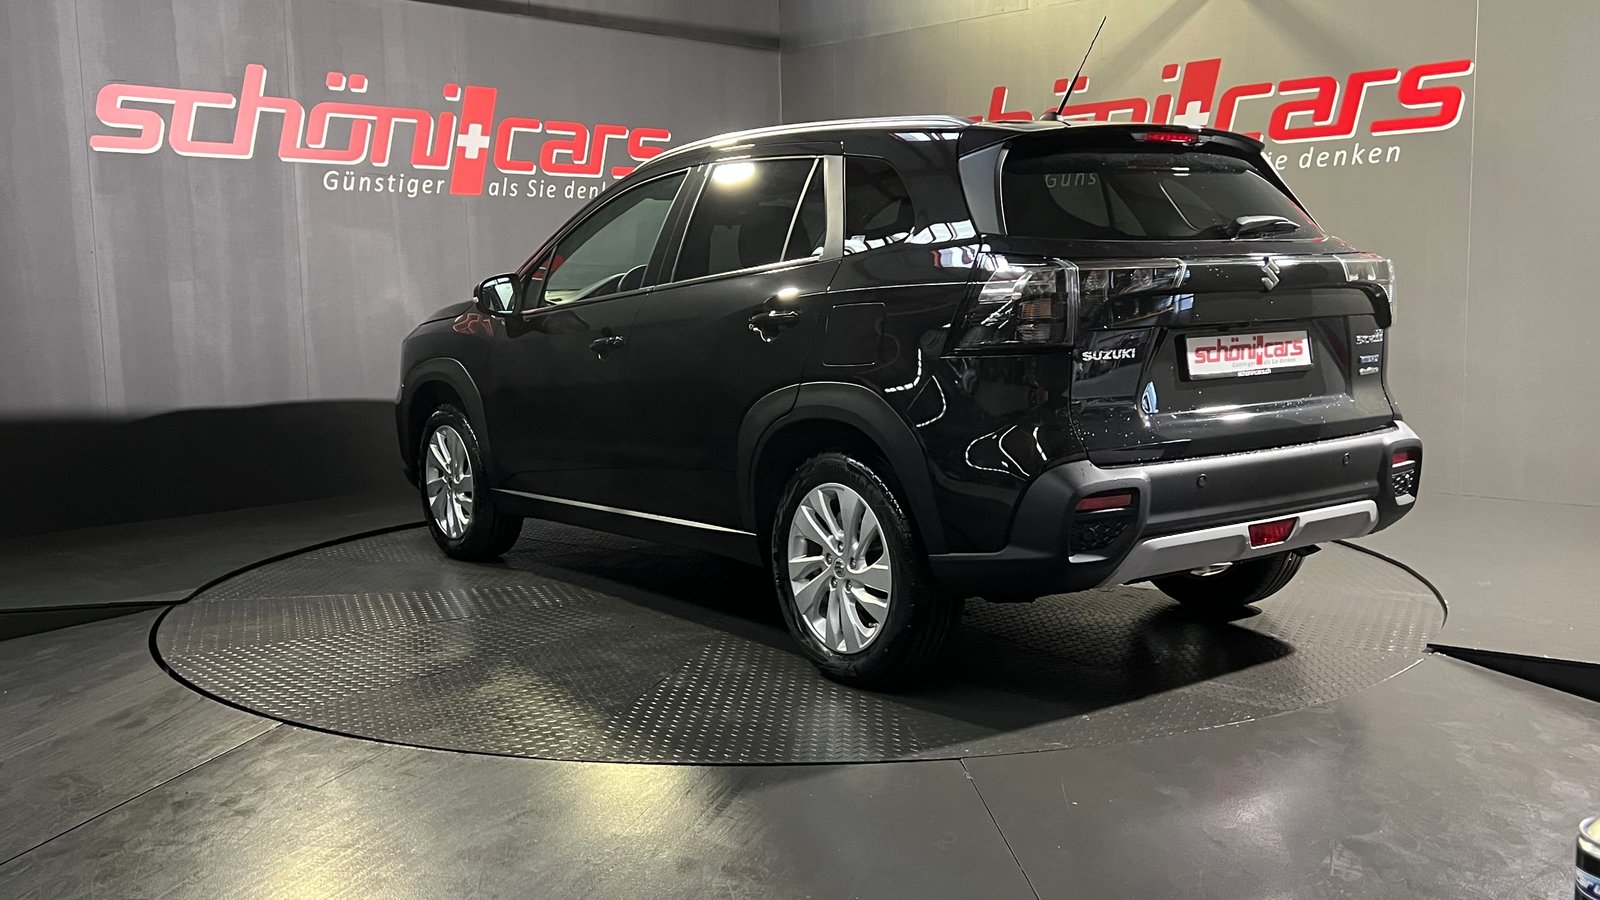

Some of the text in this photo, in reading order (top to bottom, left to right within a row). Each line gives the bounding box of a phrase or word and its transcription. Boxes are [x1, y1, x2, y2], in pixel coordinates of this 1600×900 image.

[1214, 59, 1474, 144] cars
[494, 117, 672, 179] cars
[1299, 143, 1401, 169] denken
[322, 170, 445, 198] Günstiger
[488, 177, 518, 196] als
[526, 179, 562, 198] Sie
[1082, 347, 1136, 361] SUZUKI
[1263, 339, 1303, 359] cars
